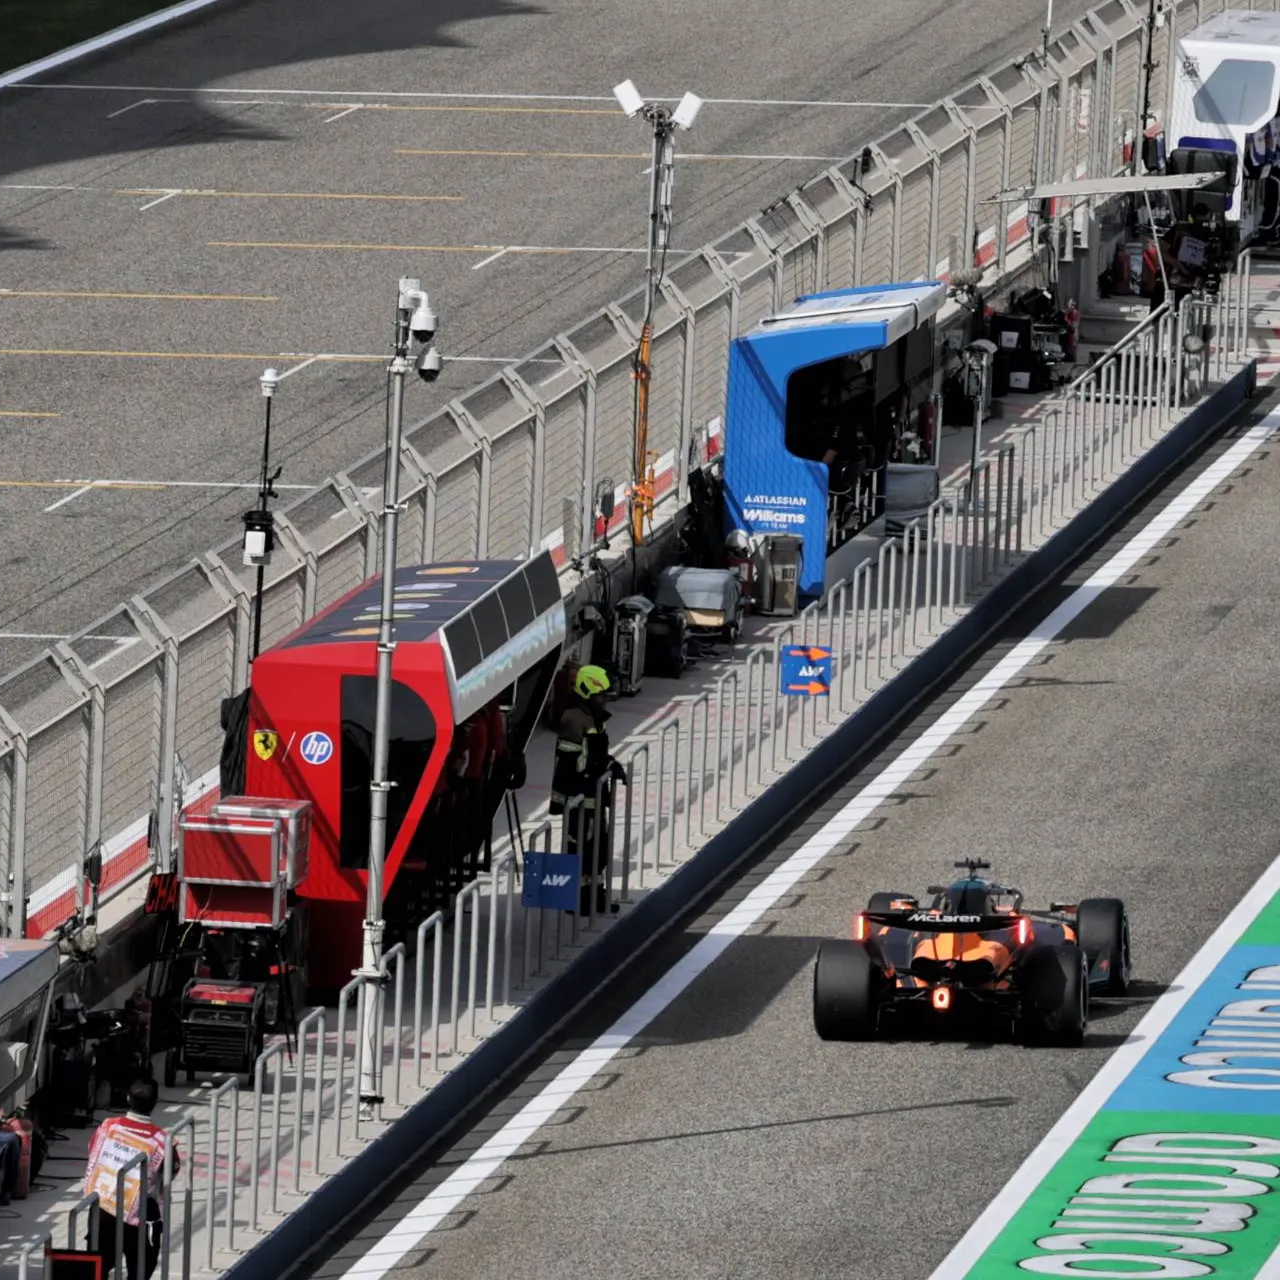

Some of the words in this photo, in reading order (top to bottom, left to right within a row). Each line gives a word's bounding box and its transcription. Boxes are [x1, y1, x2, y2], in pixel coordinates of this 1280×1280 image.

[743, 509, 805, 524] Williams
[305, 734, 329, 762] hp
[908, 914, 981, 923] McLaren
